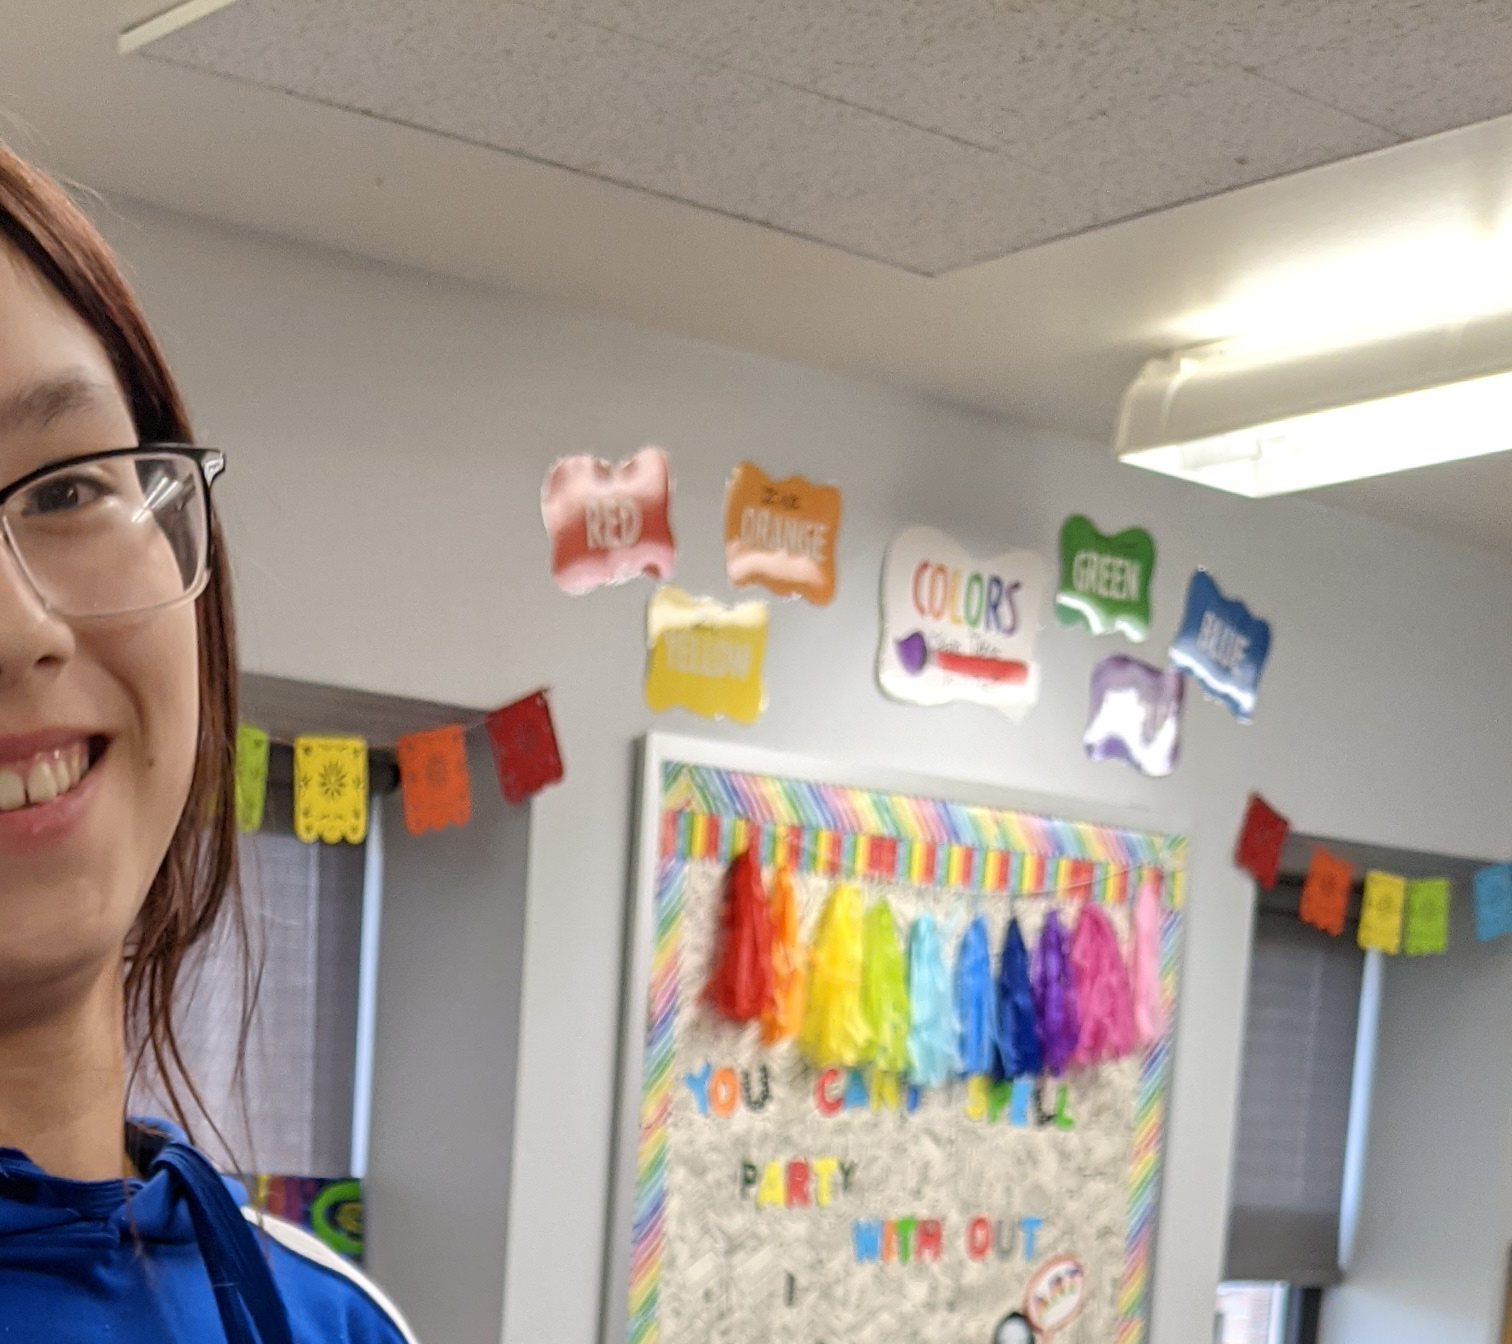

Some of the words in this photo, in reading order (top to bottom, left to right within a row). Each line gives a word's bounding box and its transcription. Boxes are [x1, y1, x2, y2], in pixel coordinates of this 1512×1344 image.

[585, 498, 642, 550] RED
[741, 506, 829, 564] ORANGE
[911, 560, 1022, 637] COLORS
[1072, 552, 1140, 600] GREEN
[684, 1061, 773, 1118] YOU
[966, 1074, 1076, 1129] SPELL
[741, 1157, 857, 1210] PARTY
[852, 1214, 943, 1265] WITH
[966, 1214, 1044, 1261] OUT
